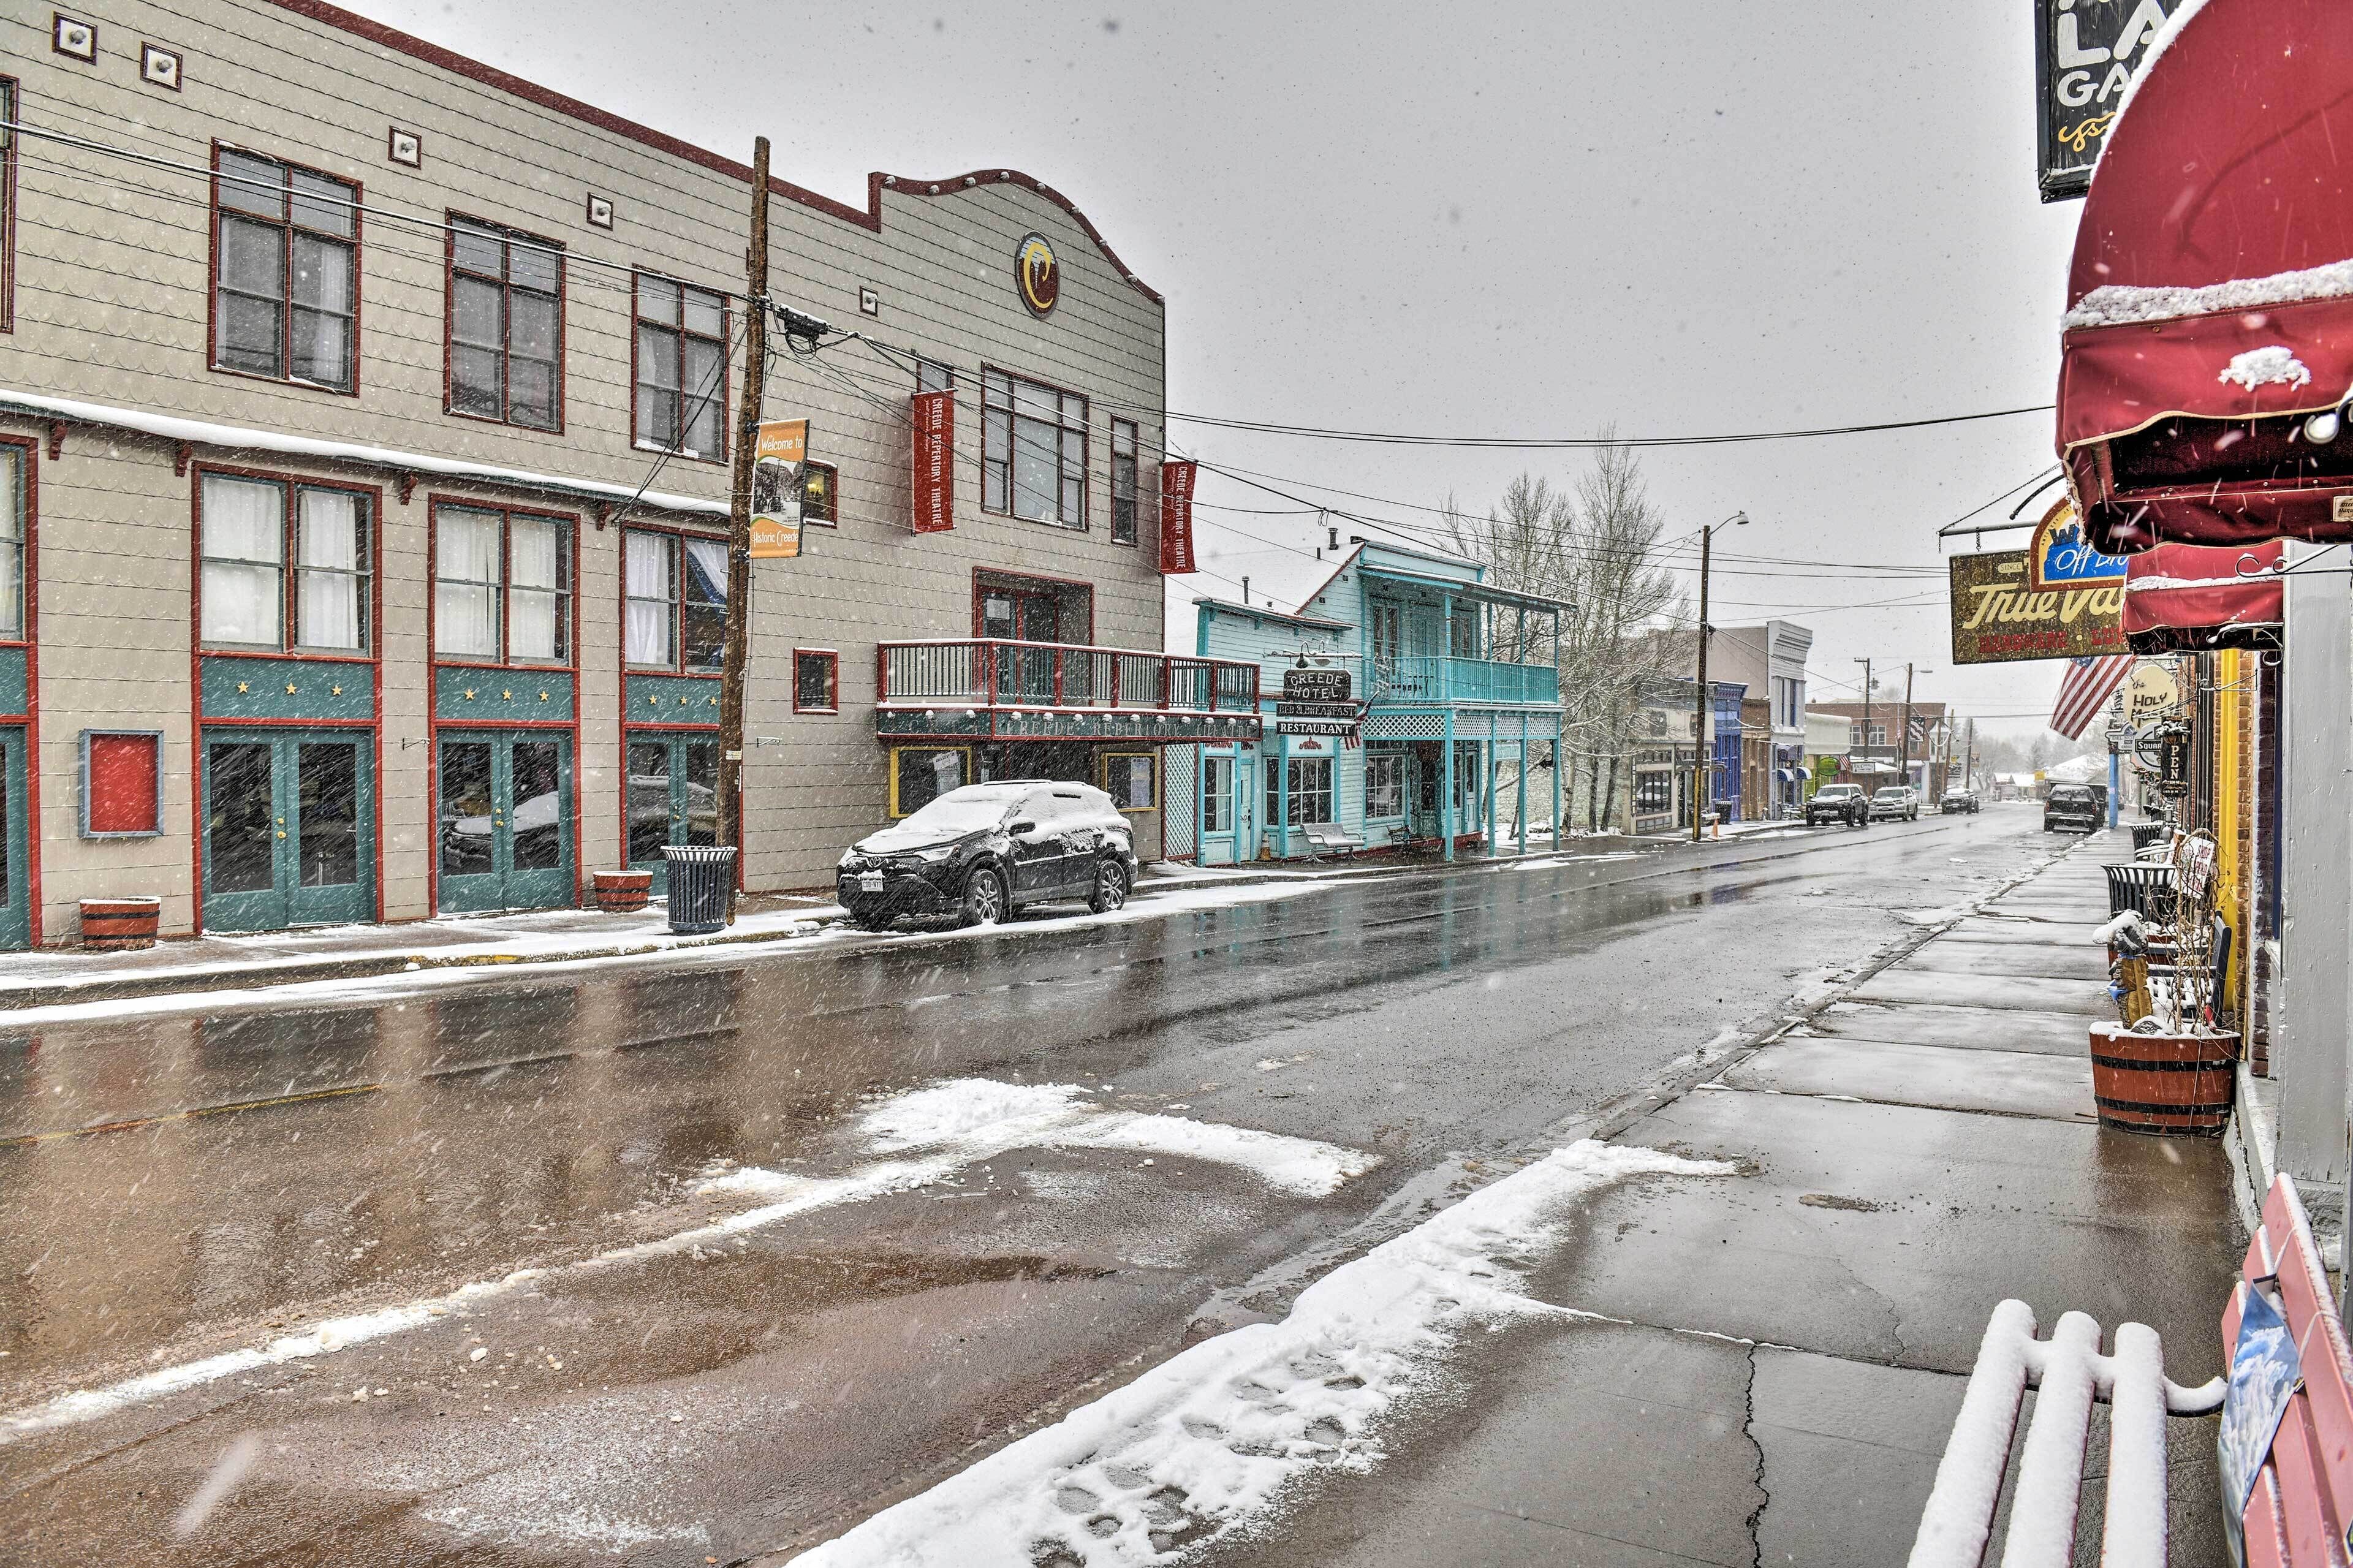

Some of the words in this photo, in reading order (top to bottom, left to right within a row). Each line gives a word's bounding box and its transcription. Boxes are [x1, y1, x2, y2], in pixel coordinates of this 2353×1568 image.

[931, 398, 943, 431] CREEDE
[761, 434, 794, 452] Welcome
[795, 434, 803, 449] to
[931, 434, 942, 483] REPERTORY
[1176, 466, 1188, 492] CREEDE
[931, 485, 943, 525] THEATRE
[1175, 494, 1184, 535] REPERTORY
[749, 531, 776, 548] Historic
[776, 529, 799, 547] Creede
[1175, 538, 1186, 569] THEATRE
[2055, 544, 2094, 576] Off
[1962, 583, 2058, 629] True
[1290, 673, 1343, 686] CREEDE
[1292, 686, 1339, 699] HOTEL
[1278, 705, 1294, 715] BED
[1295, 704, 1303, 715] &
[1304, 705, 1355, 716] BREAKFAST
[2132, 692, 2167, 706] HOLY
[1279, 723, 1351, 735] RESTAURANT
[2170, 745, 2179, 779] PEN
